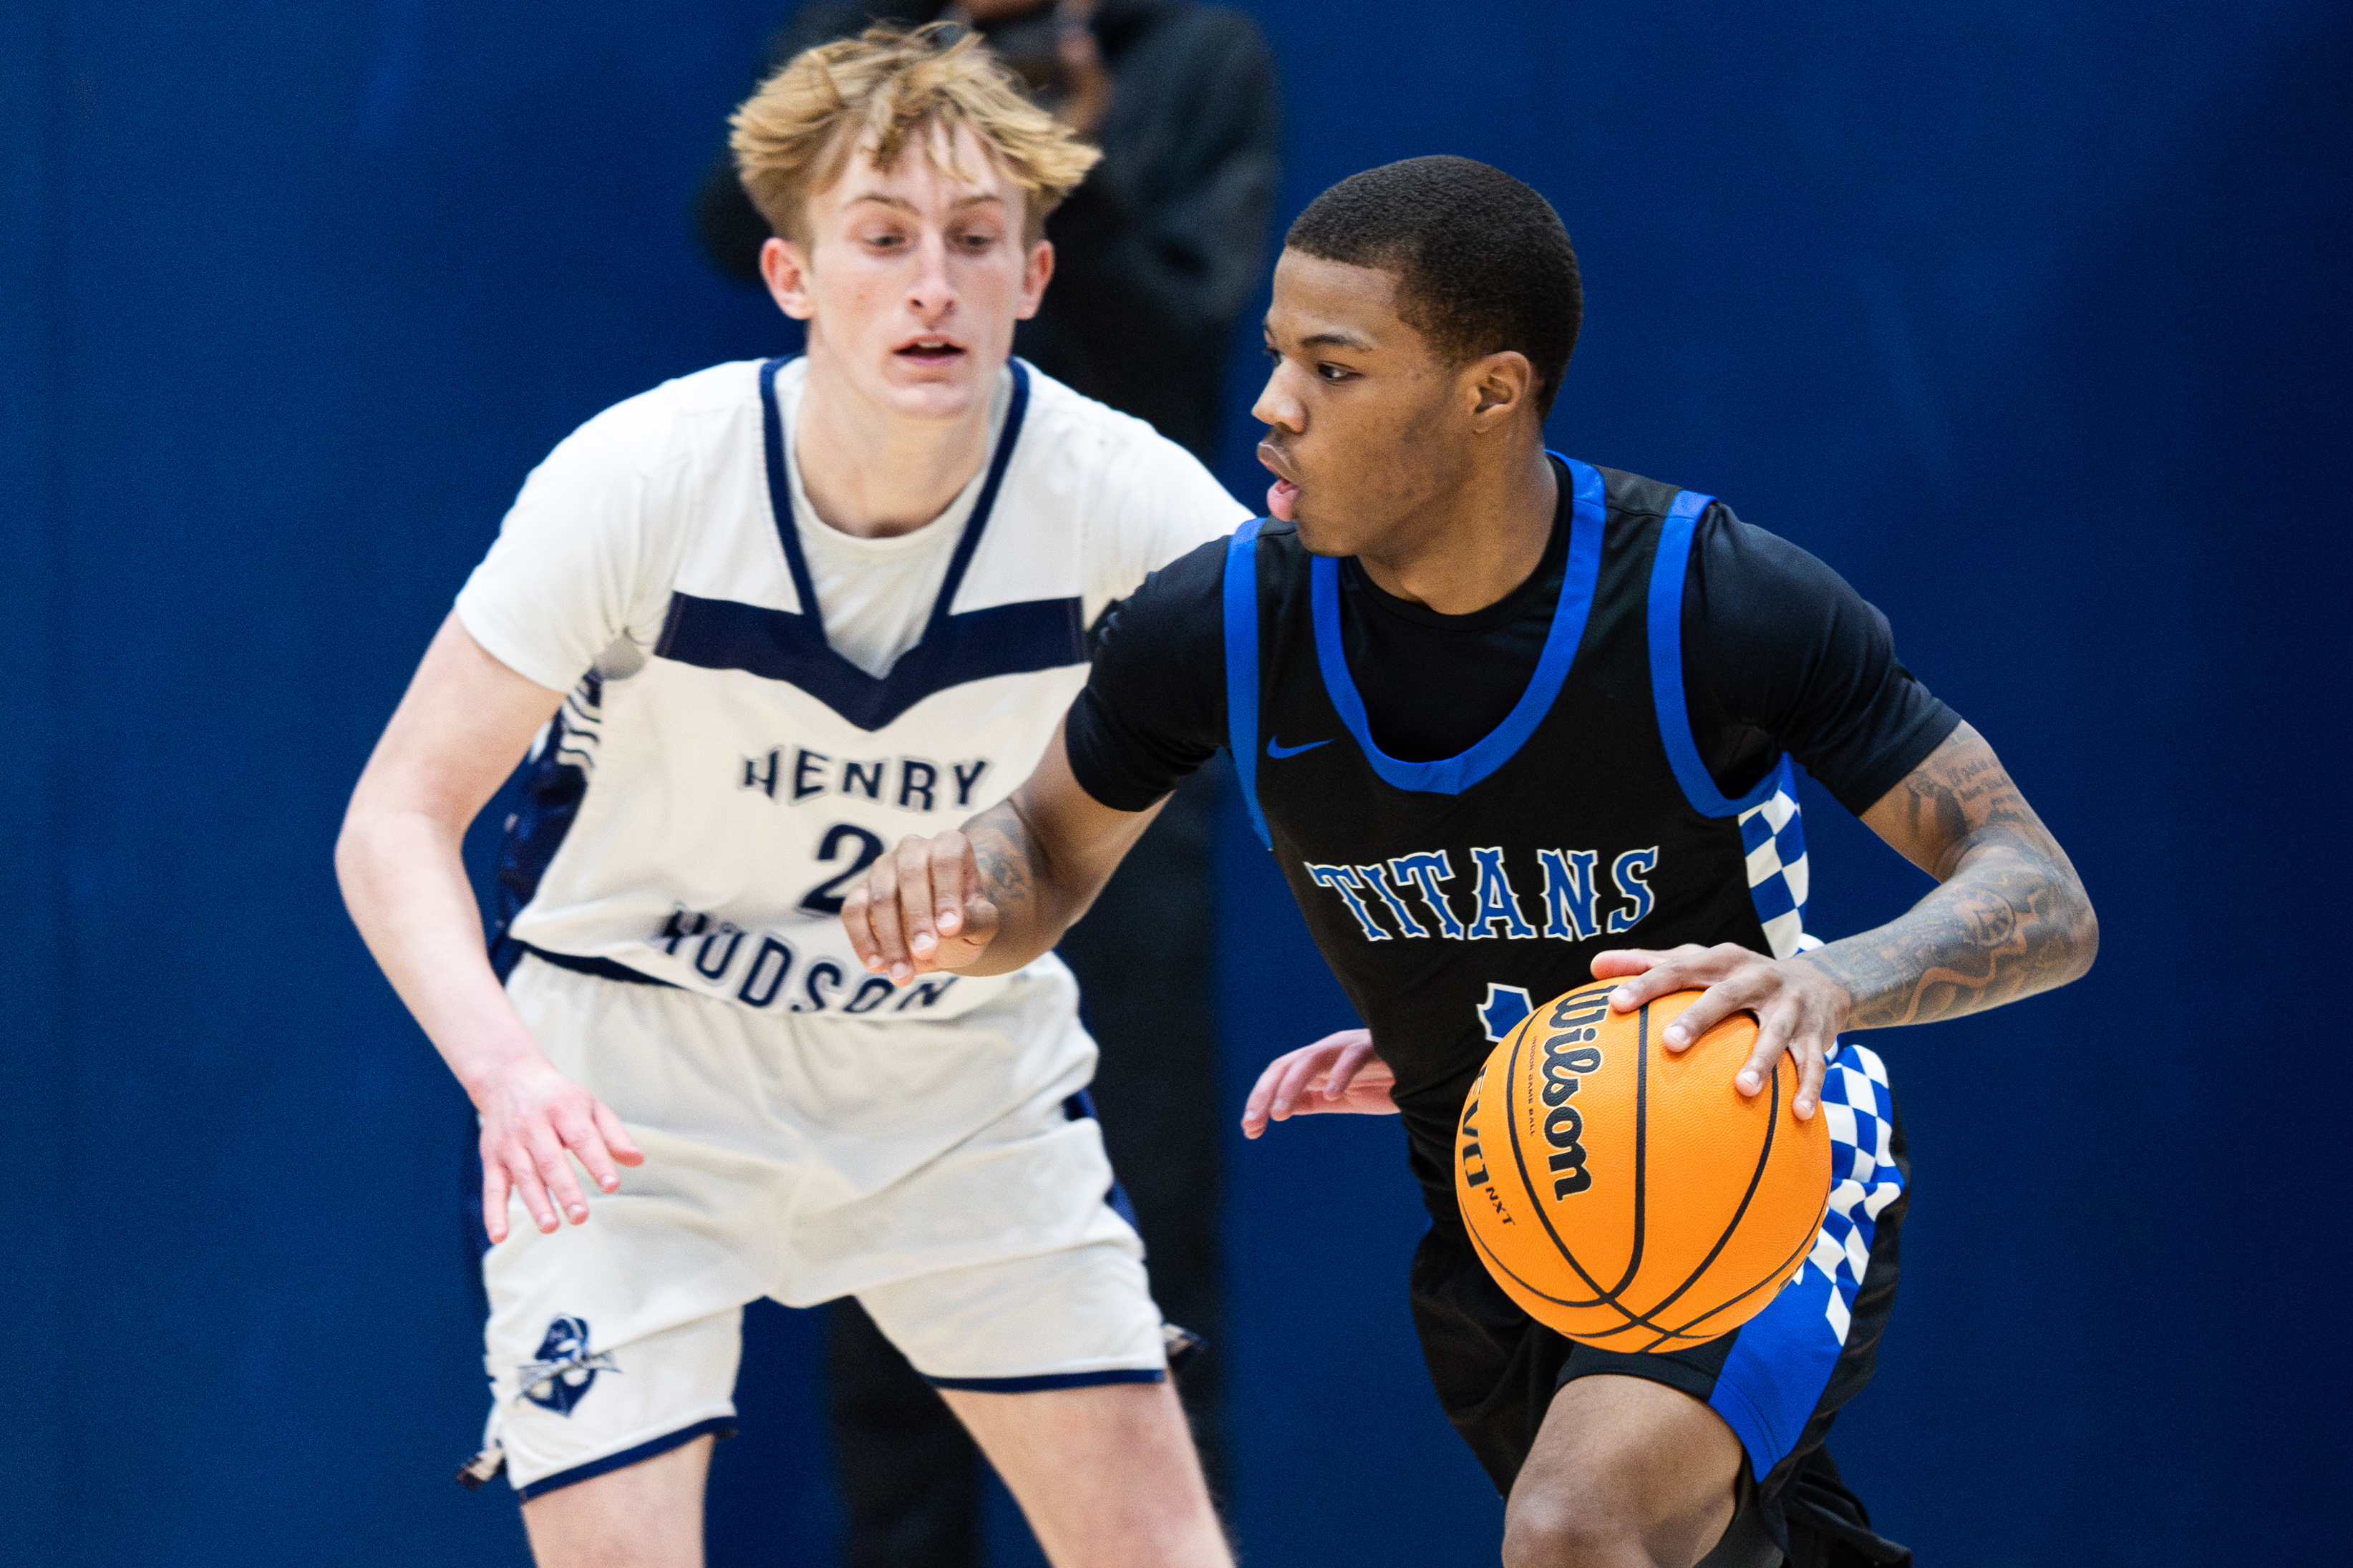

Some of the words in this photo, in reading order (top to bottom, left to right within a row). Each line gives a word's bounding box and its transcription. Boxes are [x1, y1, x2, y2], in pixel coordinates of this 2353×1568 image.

[742, 747, 988, 811] HENRY
[797, 823, 885, 915] 2
[1304, 845, 1659, 942] TITANS
[660, 909, 959, 1013] HUDSON
[1528, 1036, 1538, 1073] INDOOR
[1540, 983, 1619, 1202] Wilson
[1485, 1186, 1515, 1226] NXT
